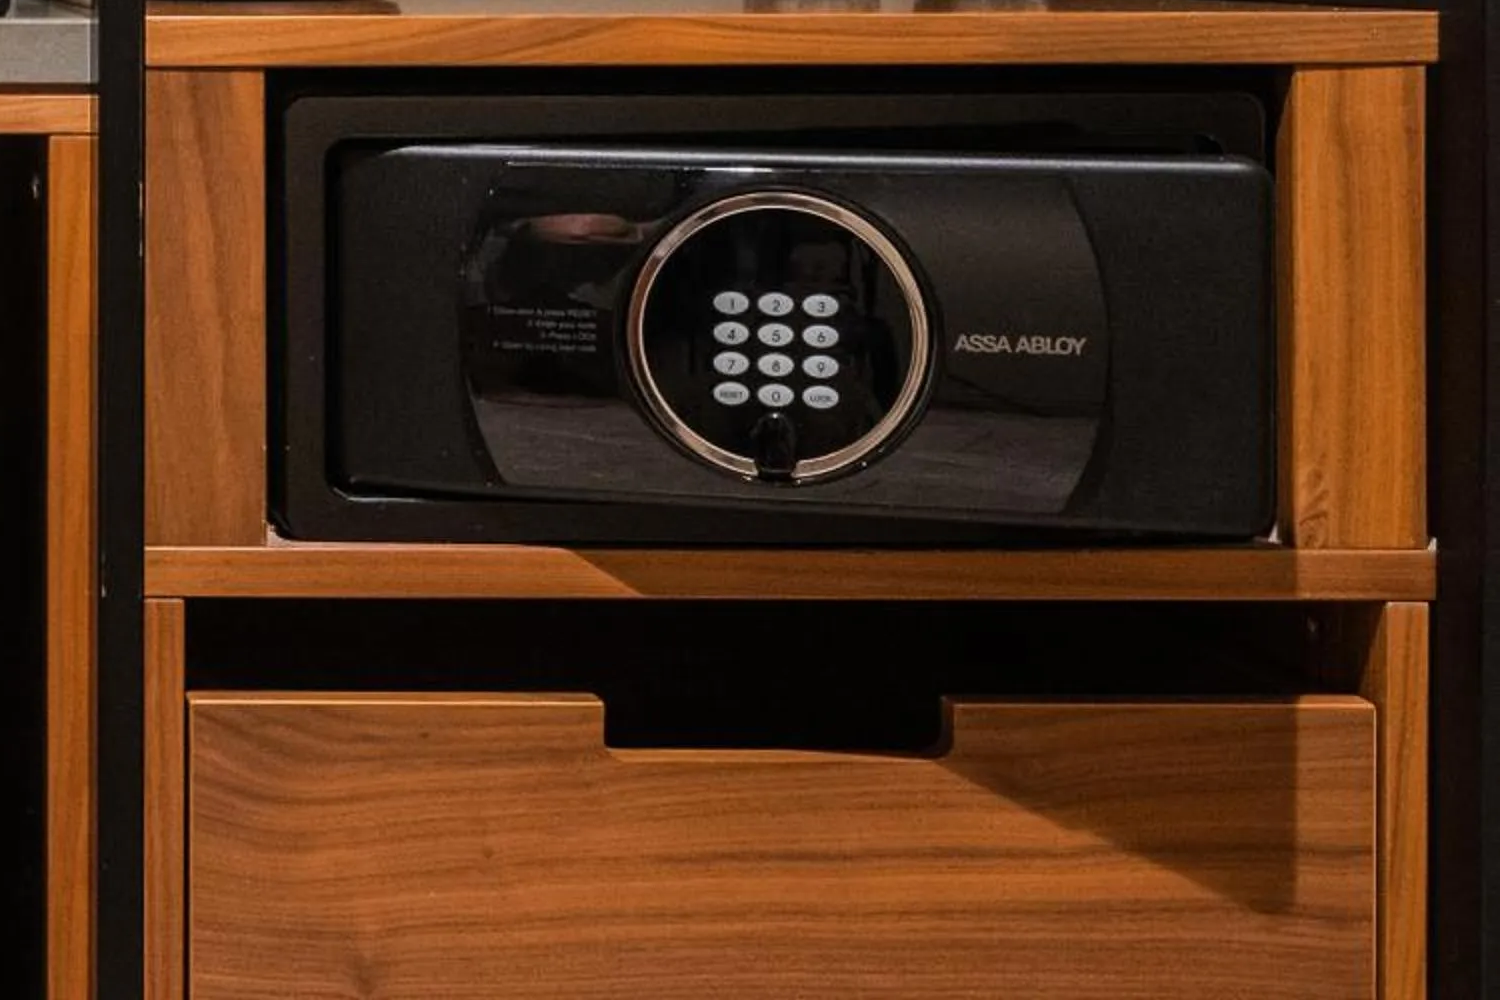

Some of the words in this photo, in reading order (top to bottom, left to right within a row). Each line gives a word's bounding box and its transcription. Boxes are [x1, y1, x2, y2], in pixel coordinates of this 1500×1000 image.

[772, 299, 781, 312] 2
[817, 301, 825, 313] 3
[727, 328, 736, 341] 4
[771, 329, 781, 342] 5
[817, 331, 826, 343] 6
[954, 333, 1013, 353] ASSA
[1015, 334, 1088, 356] ABLOY
[727, 359, 736, 371] 7
[771, 360, 781, 372] 8
[817, 361, 825, 373] 9
[771, 391, 781, 403] 0
